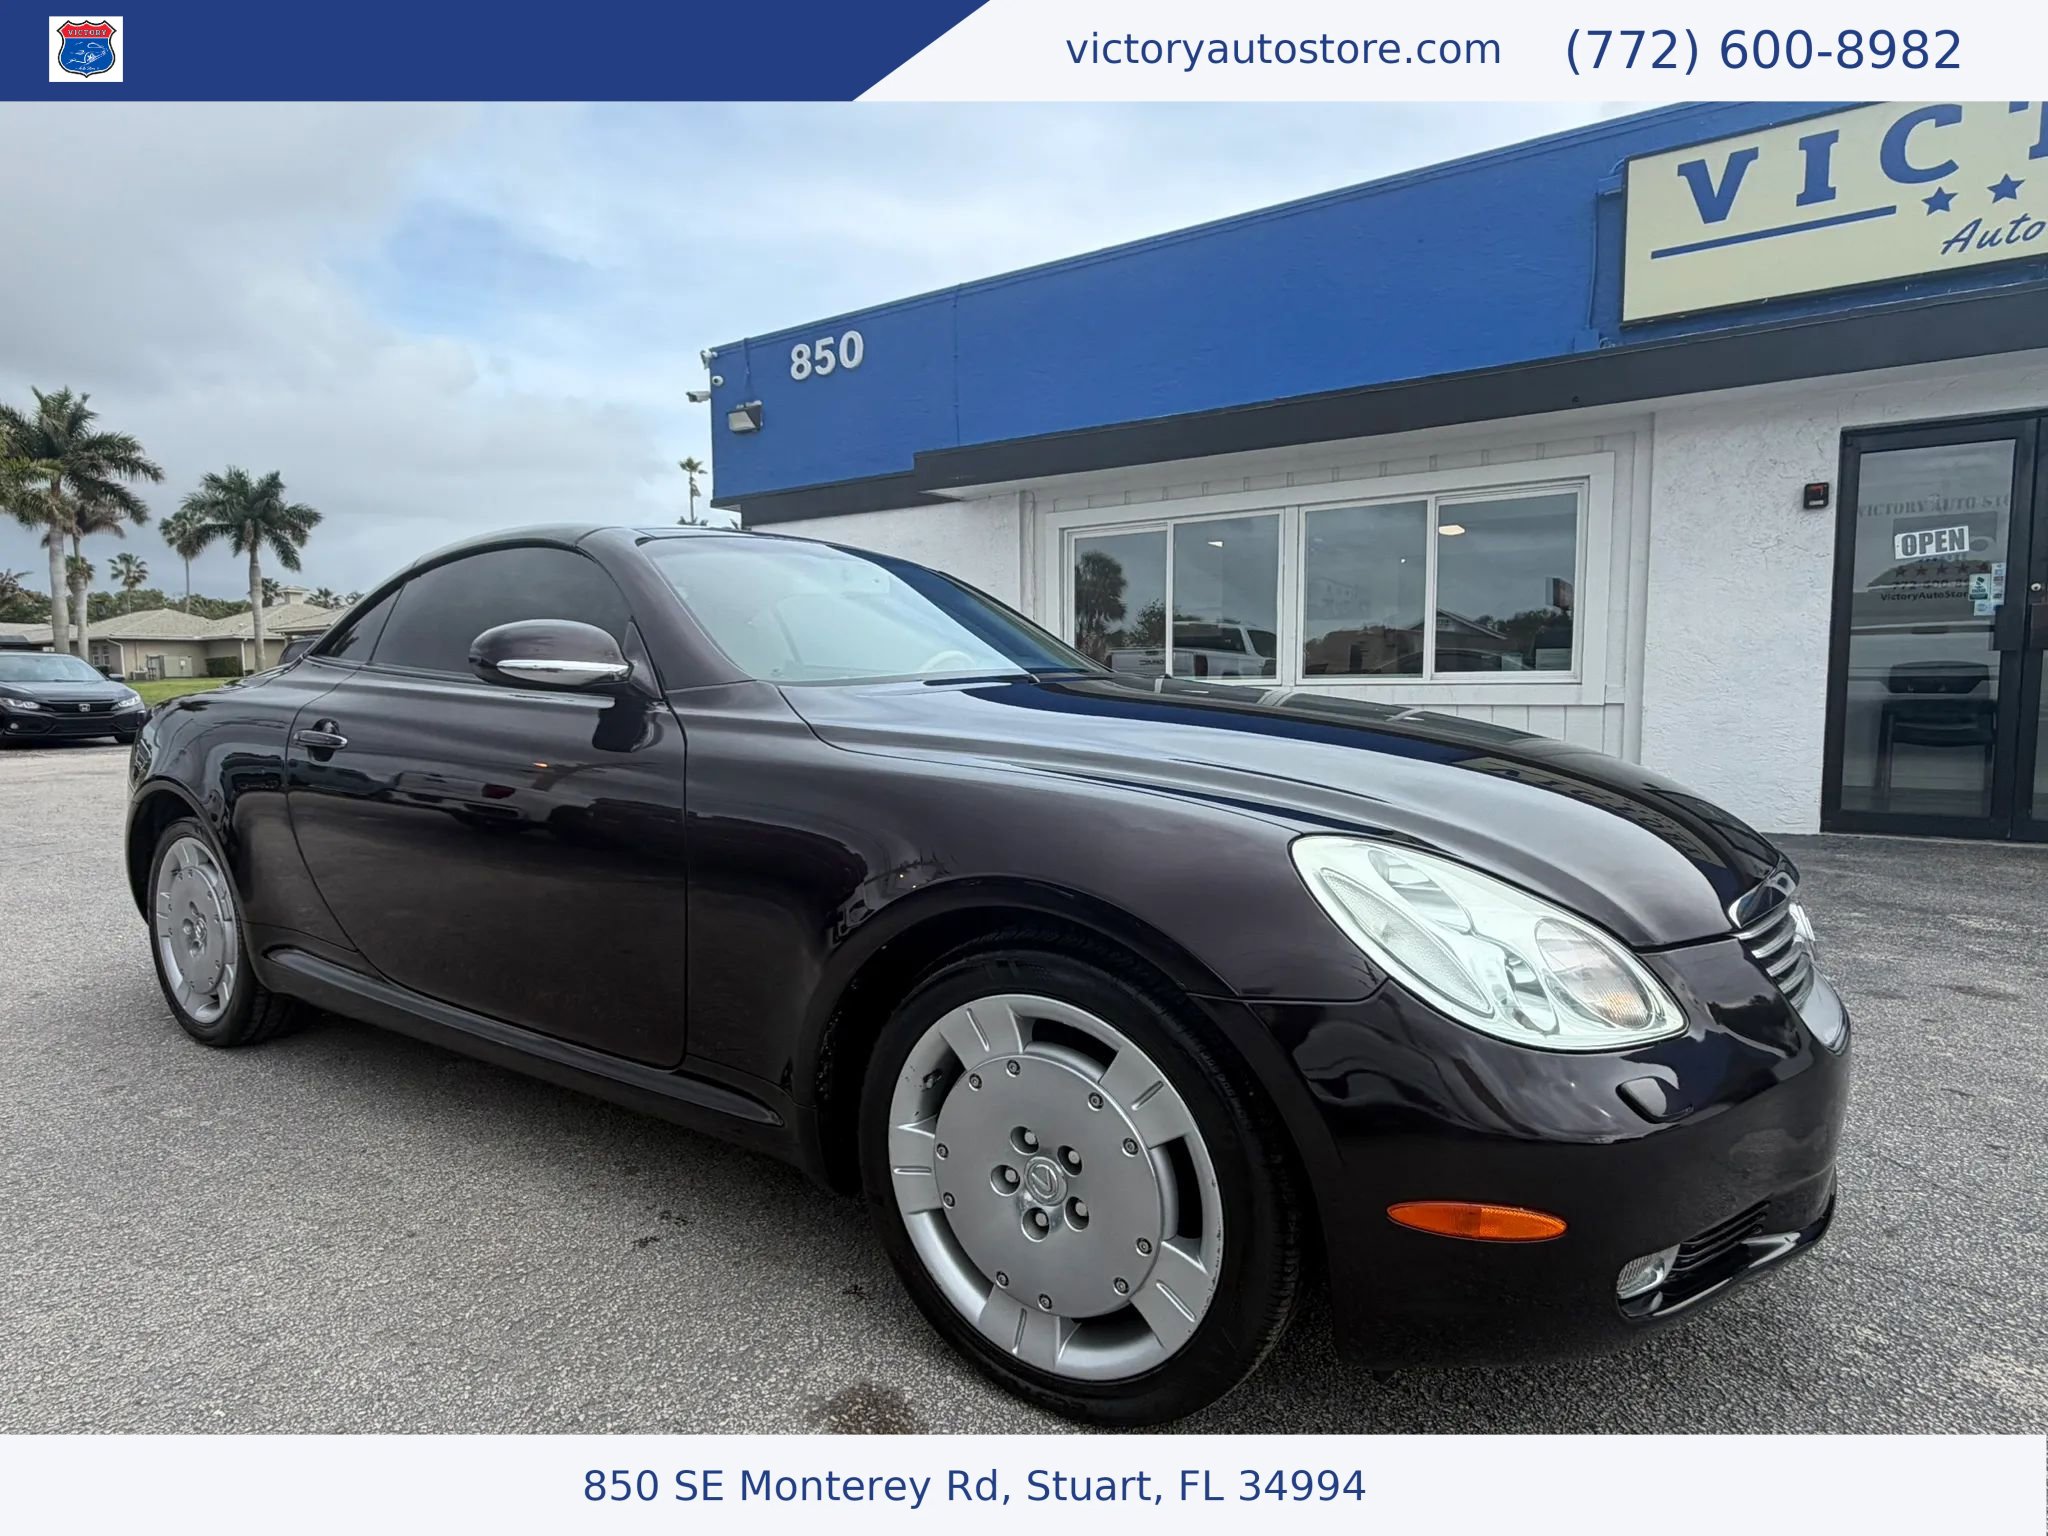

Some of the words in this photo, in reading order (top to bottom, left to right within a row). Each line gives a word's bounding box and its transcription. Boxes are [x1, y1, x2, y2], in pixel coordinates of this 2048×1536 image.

[1941, 213, 2047, 255] Auto
[790, 329, 865, 381] 850
[1901, 528, 1965, 557] OPEN
[1880, 590, 1969, 601] VictoryAutoStor
